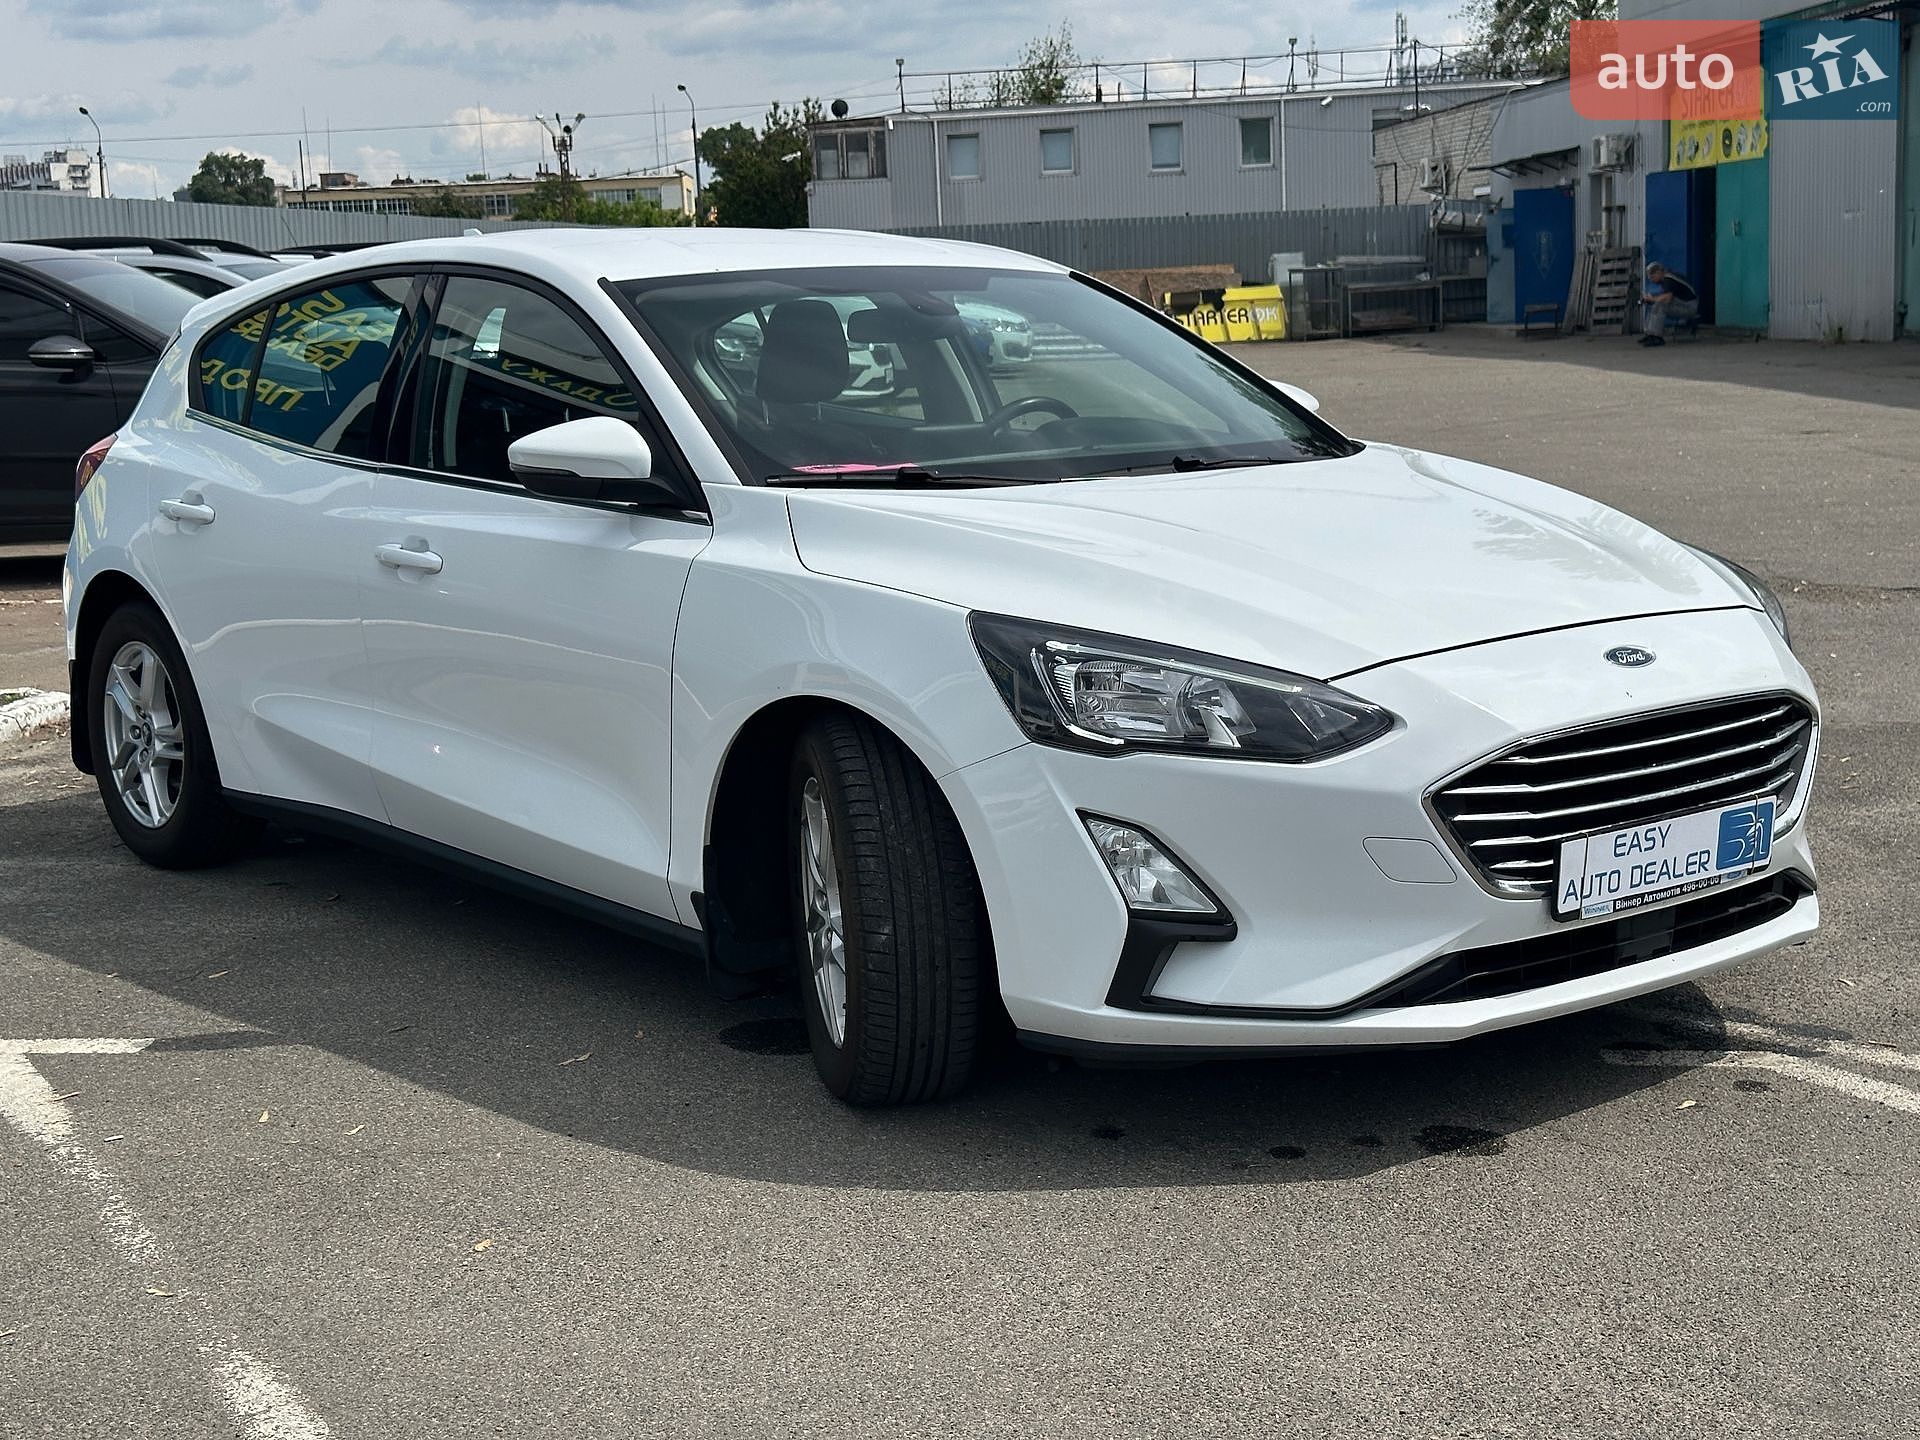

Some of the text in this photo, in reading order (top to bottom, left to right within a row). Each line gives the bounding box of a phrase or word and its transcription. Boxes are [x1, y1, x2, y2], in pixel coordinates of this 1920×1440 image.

[1615, 650, 1646, 664] Ford
[1613, 824, 1672, 858] EASY
[1563, 849, 1711, 904] AUTO DEALER
